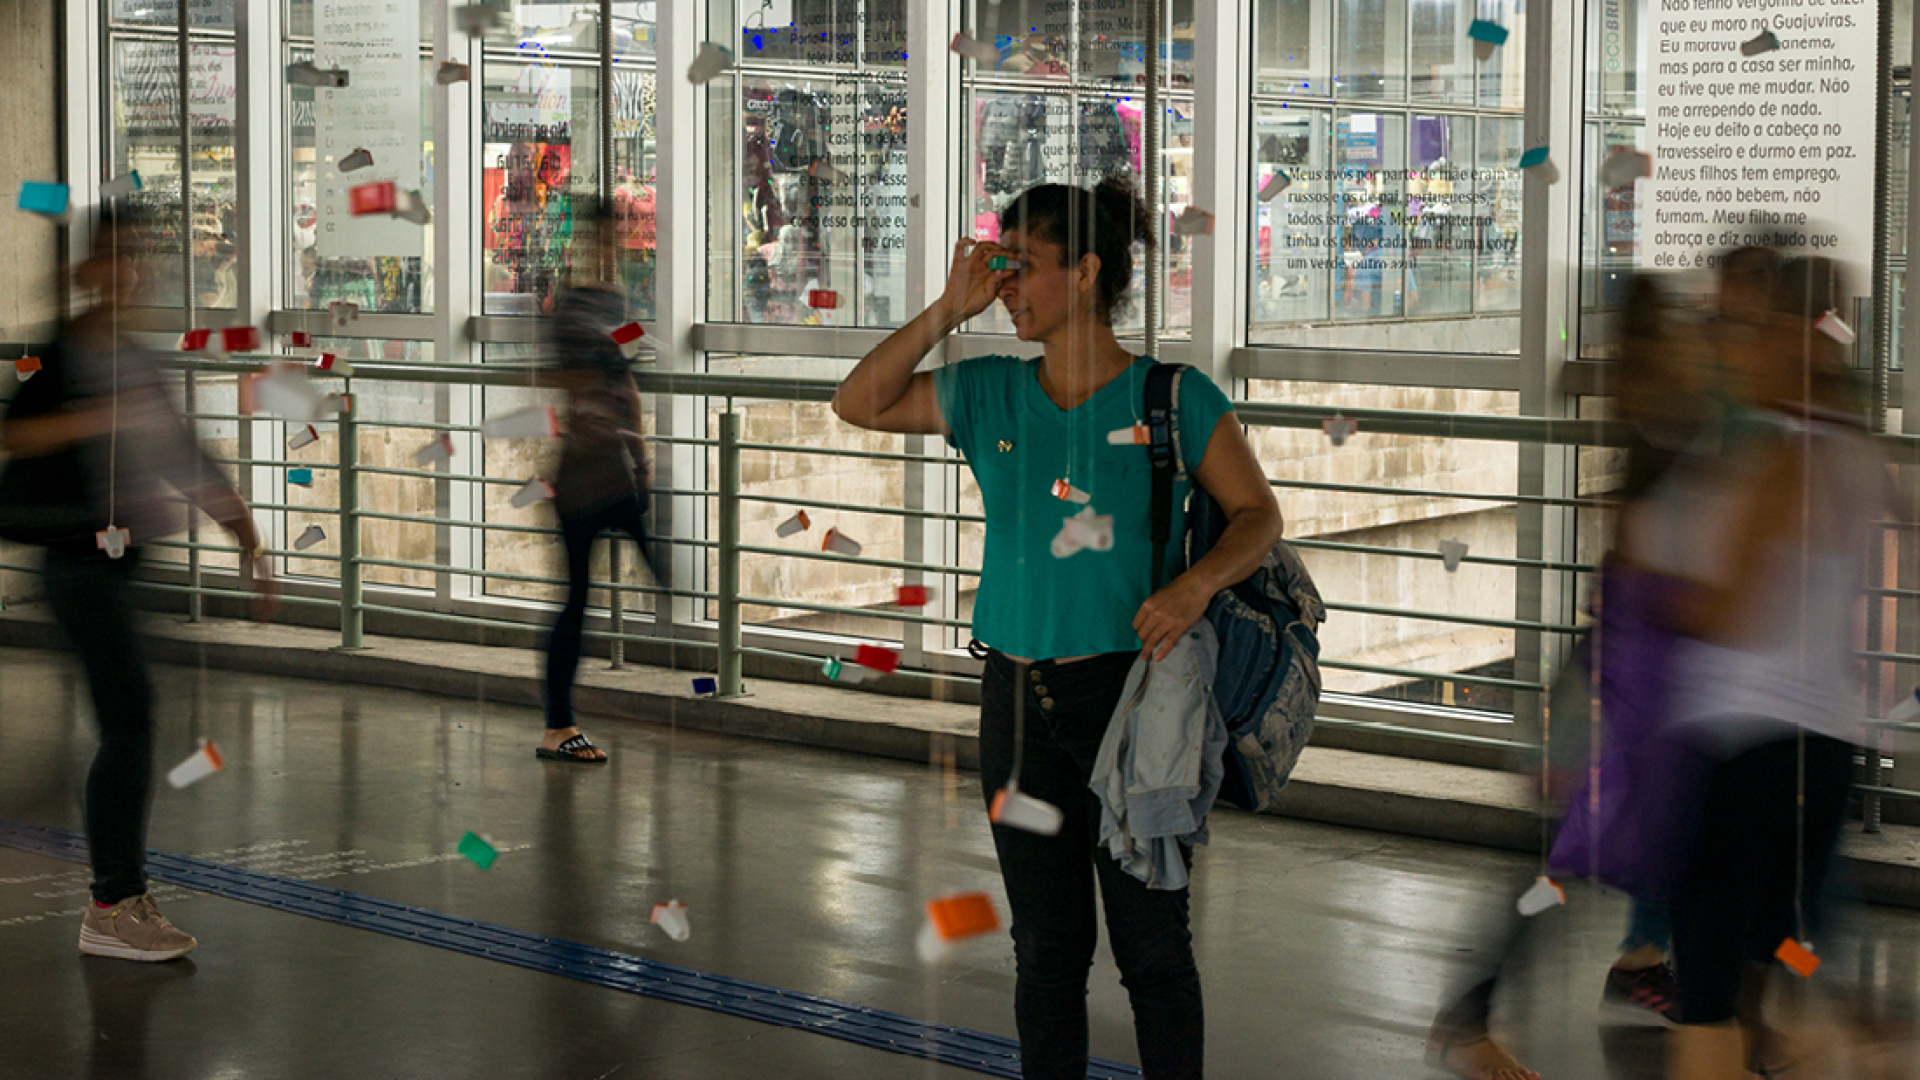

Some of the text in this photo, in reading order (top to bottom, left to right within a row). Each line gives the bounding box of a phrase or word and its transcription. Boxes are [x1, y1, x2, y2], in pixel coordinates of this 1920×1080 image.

[1660, 12, 1856, 35] que eu moro no Guajuviras.
[1660, 40, 1679, 53] Eu
[1684, 41, 1735, 52] morava
[1660, 56, 1854, 76] mas para a casa ser minha,
[1658, 78, 1850, 97] eu tive que me mudar. Não
[1658, 101, 1821, 117] me arrependo de nada.
[1658, 122, 1841, 140] Hoje eu deito a cabeça no
[1657, 144, 1856, 160] travesseiro e durmo em paz.
[1290, 166, 1322, 180] Meus
[1657, 166, 1840, 183] Meus filhos tem emprego,
[1288, 193, 1329, 203] russos
[1656, 187, 1820, 202] saúde, não bebem, não
[1288, 211, 1323, 225] todos
[1656, 209, 1807, 224] fumam. Meu filho me
[1287, 234, 1320, 248] tinha
[1378, 234, 1407, 248] cada
[1655, 230, 1838, 250] abraça e diz que tudo que
[1288, 259, 1308, 270] um
[1654, 252, 1674, 265] ele
[1679, 251, 1691, 267] é,
[1695, 251, 1704, 265] é
